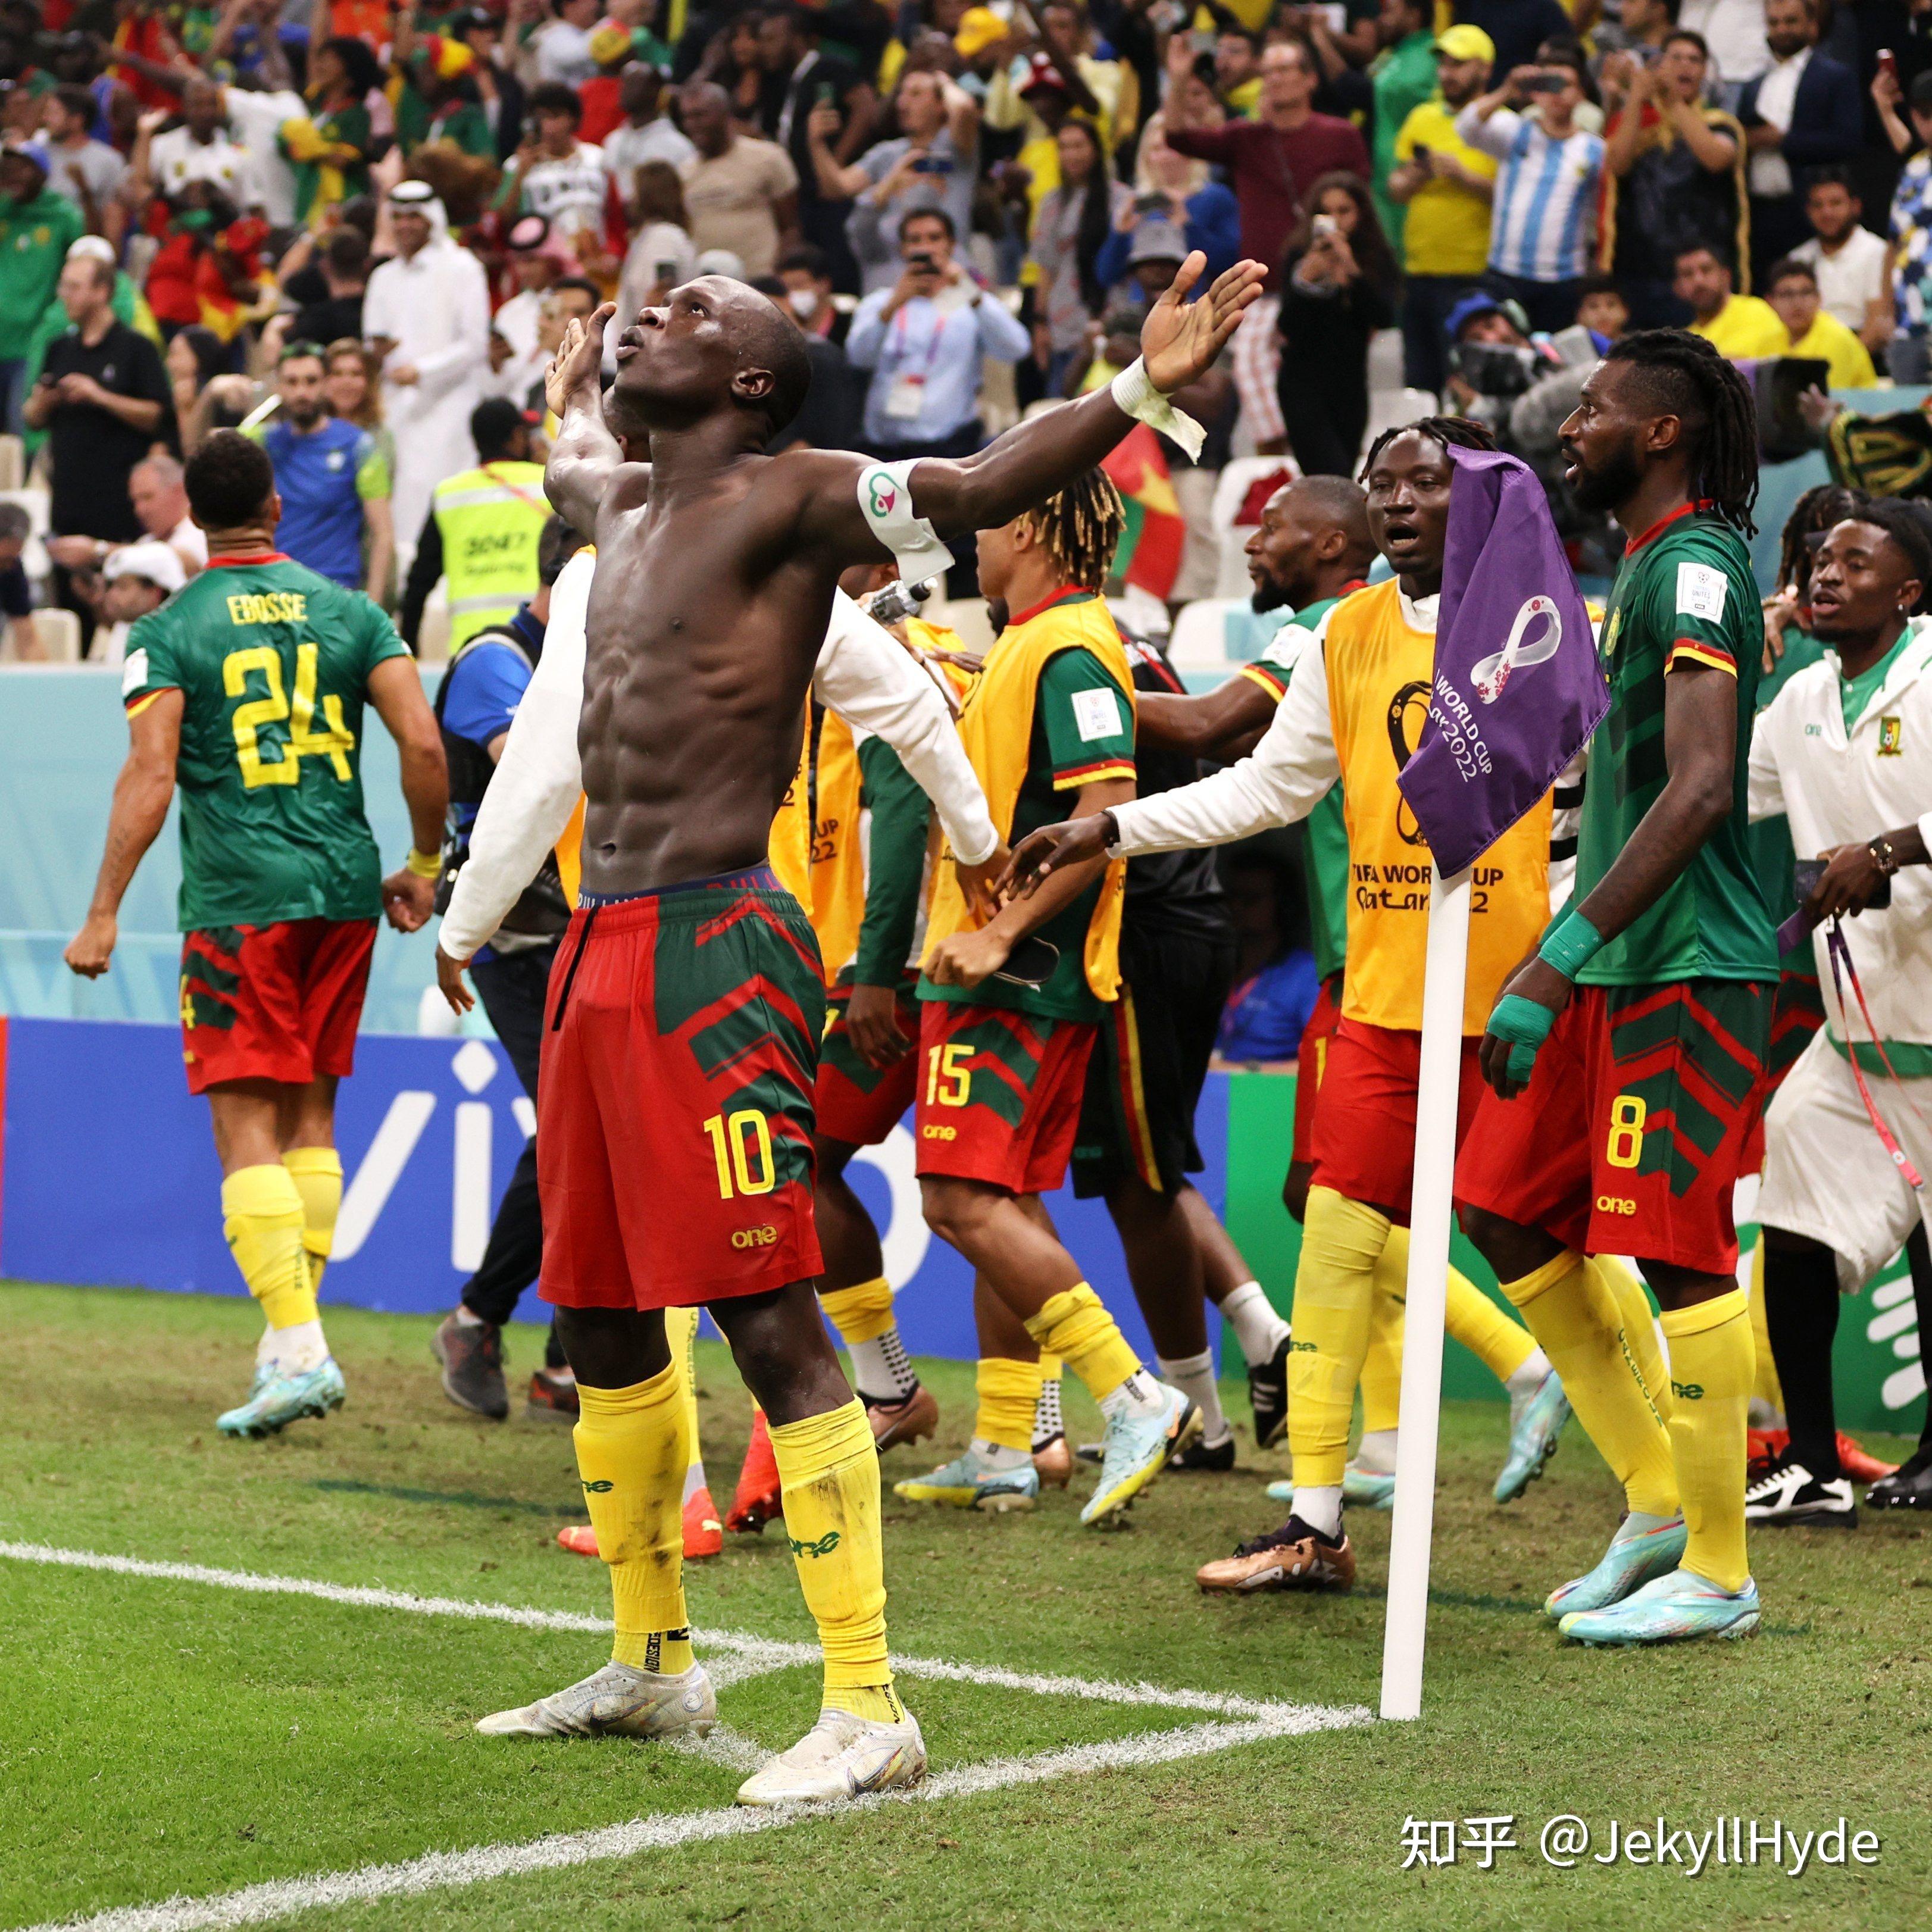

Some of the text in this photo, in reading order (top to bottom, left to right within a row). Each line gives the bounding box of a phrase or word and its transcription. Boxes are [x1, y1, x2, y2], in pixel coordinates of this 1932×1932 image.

[223, 642, 355, 789] 24
[1436, 675, 1493, 774] WORLD CUP
[817, 818, 839, 838] UP
[1383, 864, 1431, 884] WOR
[1471, 868, 1504, 886] UP
[180, 974, 196, 1030] 4
[926, 1043, 976, 1106] 15
[923, 1124, 957, 1142] one
[1607, 1095, 1647, 1168] 8
[703, 1109, 776, 1200] 10
[1596, 1195, 1637, 1216] one
[731, 1226, 777, 1250] one
[1289, 1340, 1318, 1353] ne
[1671, 1380, 1705, 1400] ne
